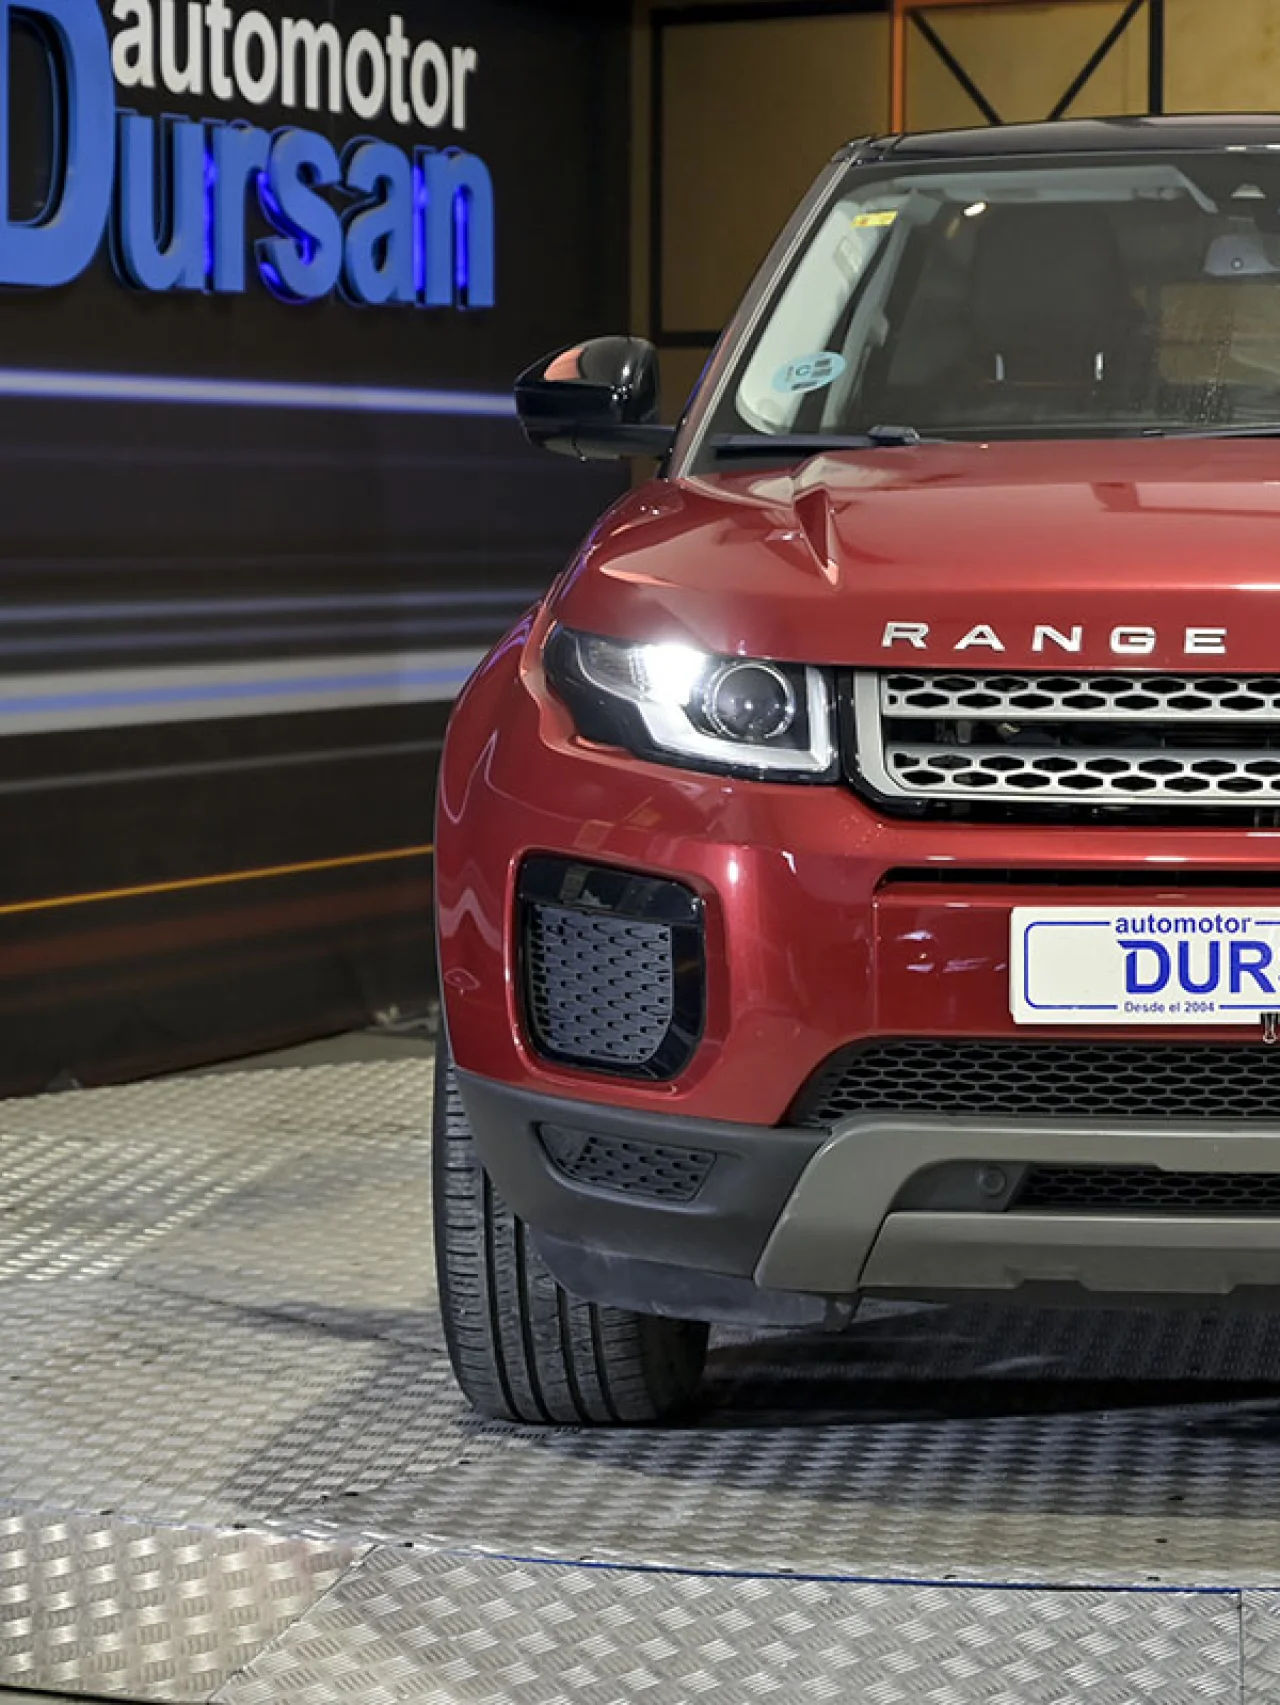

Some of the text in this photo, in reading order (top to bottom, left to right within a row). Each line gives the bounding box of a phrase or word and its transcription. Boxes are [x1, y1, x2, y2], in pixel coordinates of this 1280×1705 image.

[111, 0, 477, 131] automotor
[0, 0, 496, 310] Dursan
[881, 622, 1227, 654] RANGE
[1115, 912, 1252, 934] automotor
[1124, 1000, 1216, 1013] Desde el 2004
